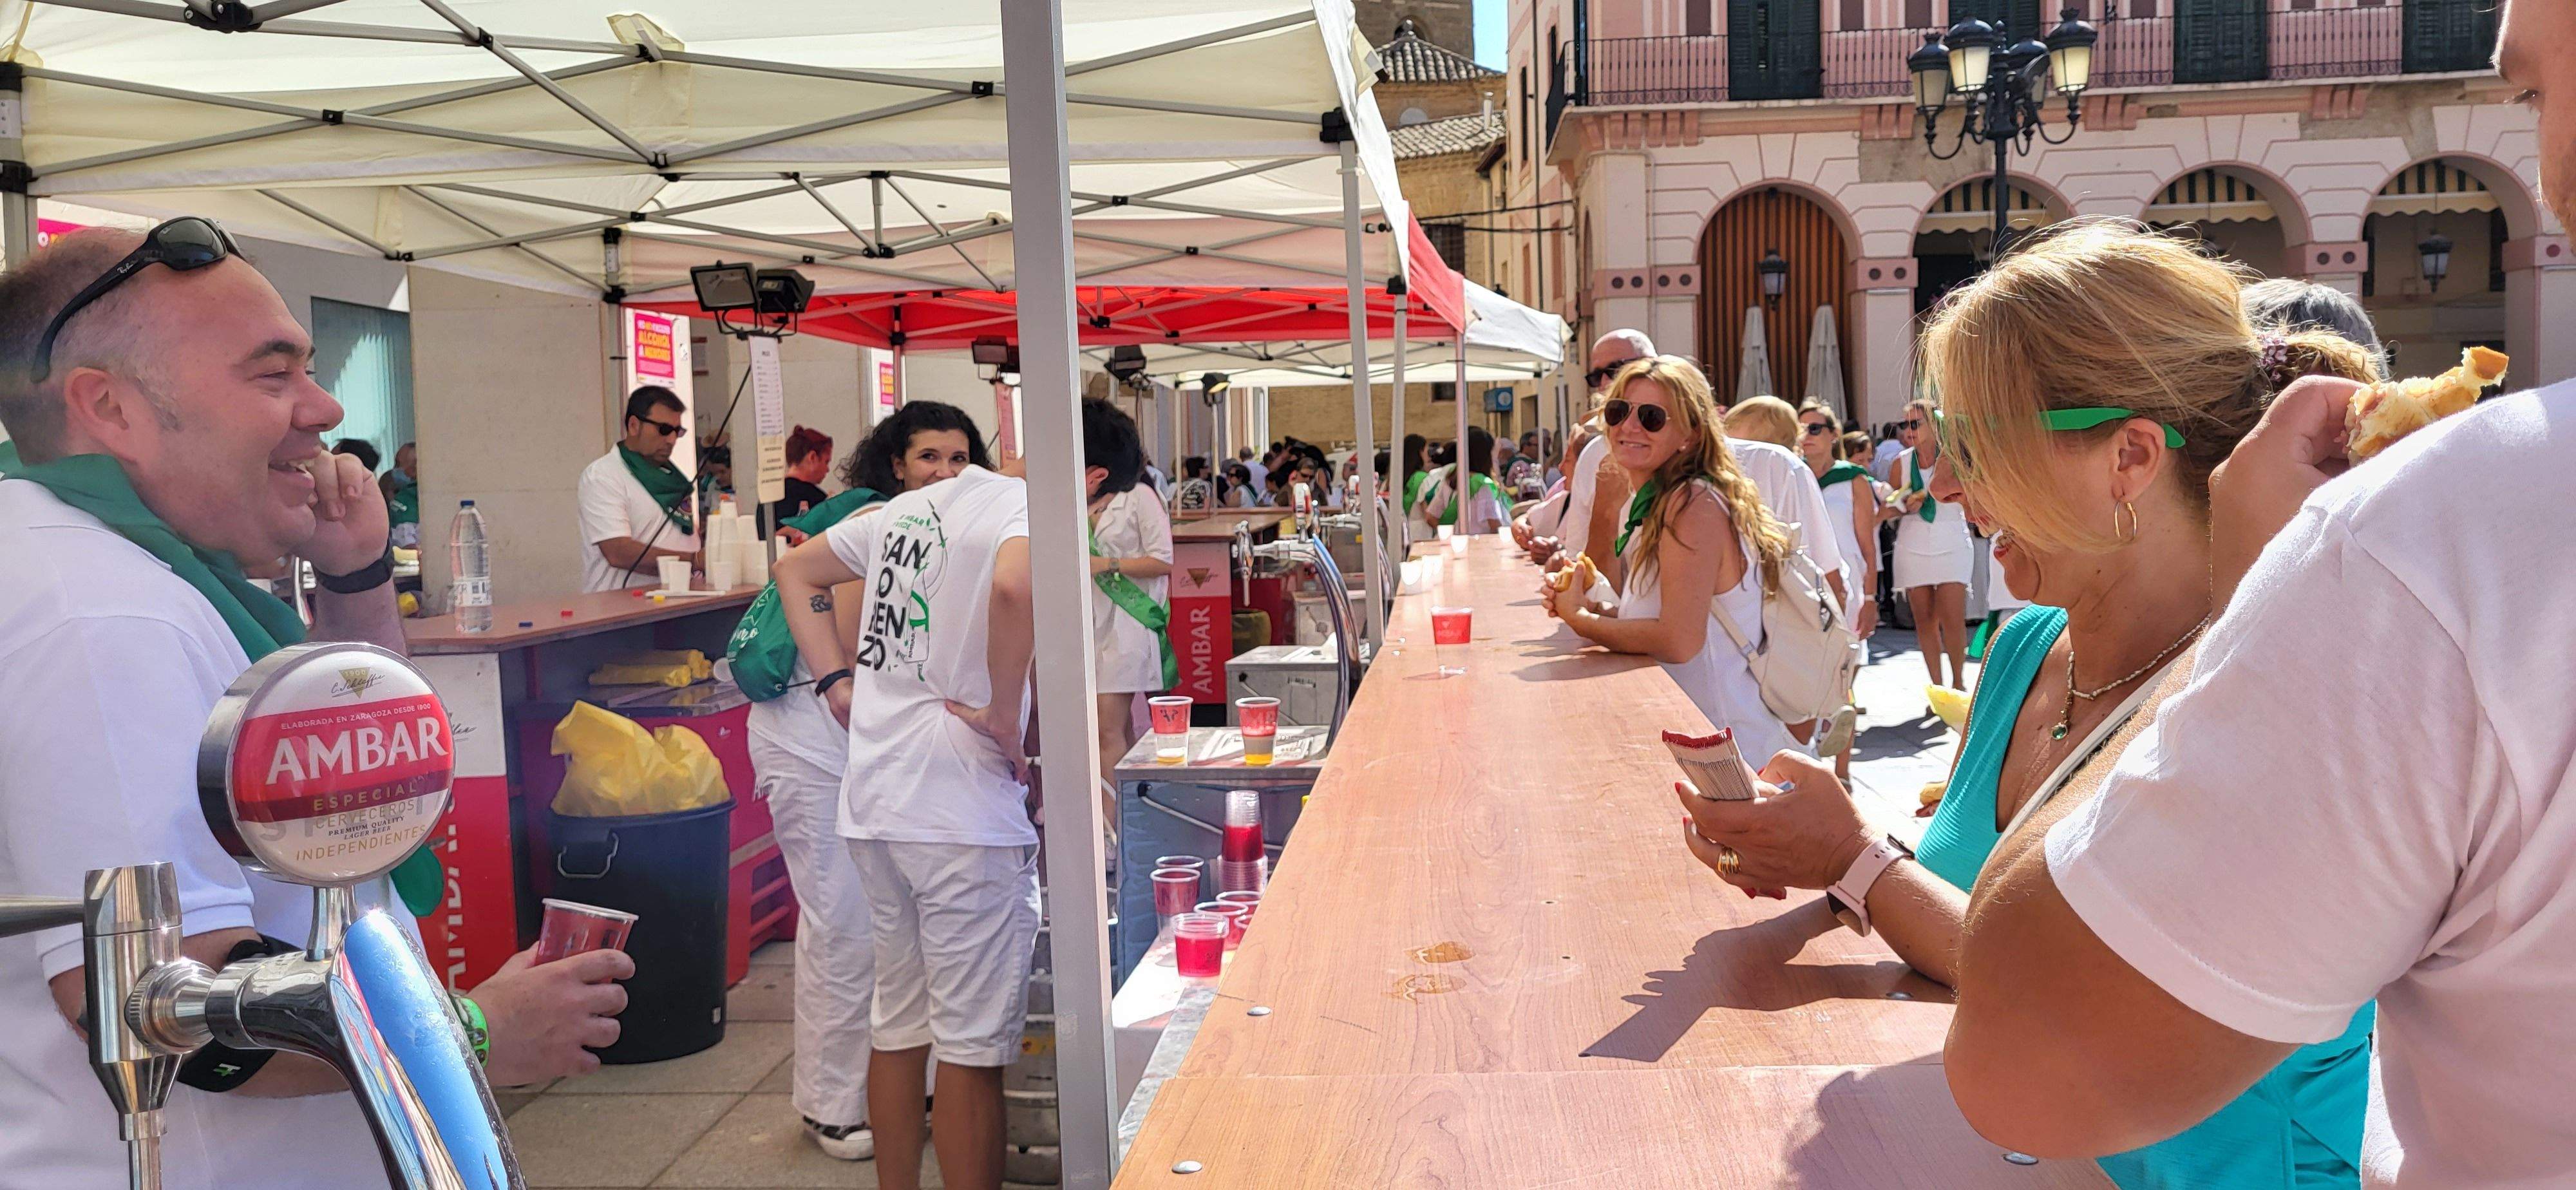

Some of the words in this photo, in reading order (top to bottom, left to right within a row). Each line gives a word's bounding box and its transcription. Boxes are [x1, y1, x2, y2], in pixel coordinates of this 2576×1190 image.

[1189, 604, 1213, 694] AMBAR
[281, 718, 333, 730] ELABORADA
[350, 709, 392, 722] ZARAGOZA
[393, 705, 415, 714] DESDE
[417, 703, 431, 711] 1900
[265, 716, 449, 785] AMBAR
[314, 781, 417, 811] ESPECIAL
[316, 798, 415, 829] CERVECEROS
[328, 824, 368, 836] PREMIUM
[371, 815, 405, 829] QUALITY
[296, 824, 426, 862] INDEPENDIENTES
[343, 830, 370, 841] LAGER
[372, 825, 392, 835] BEER
